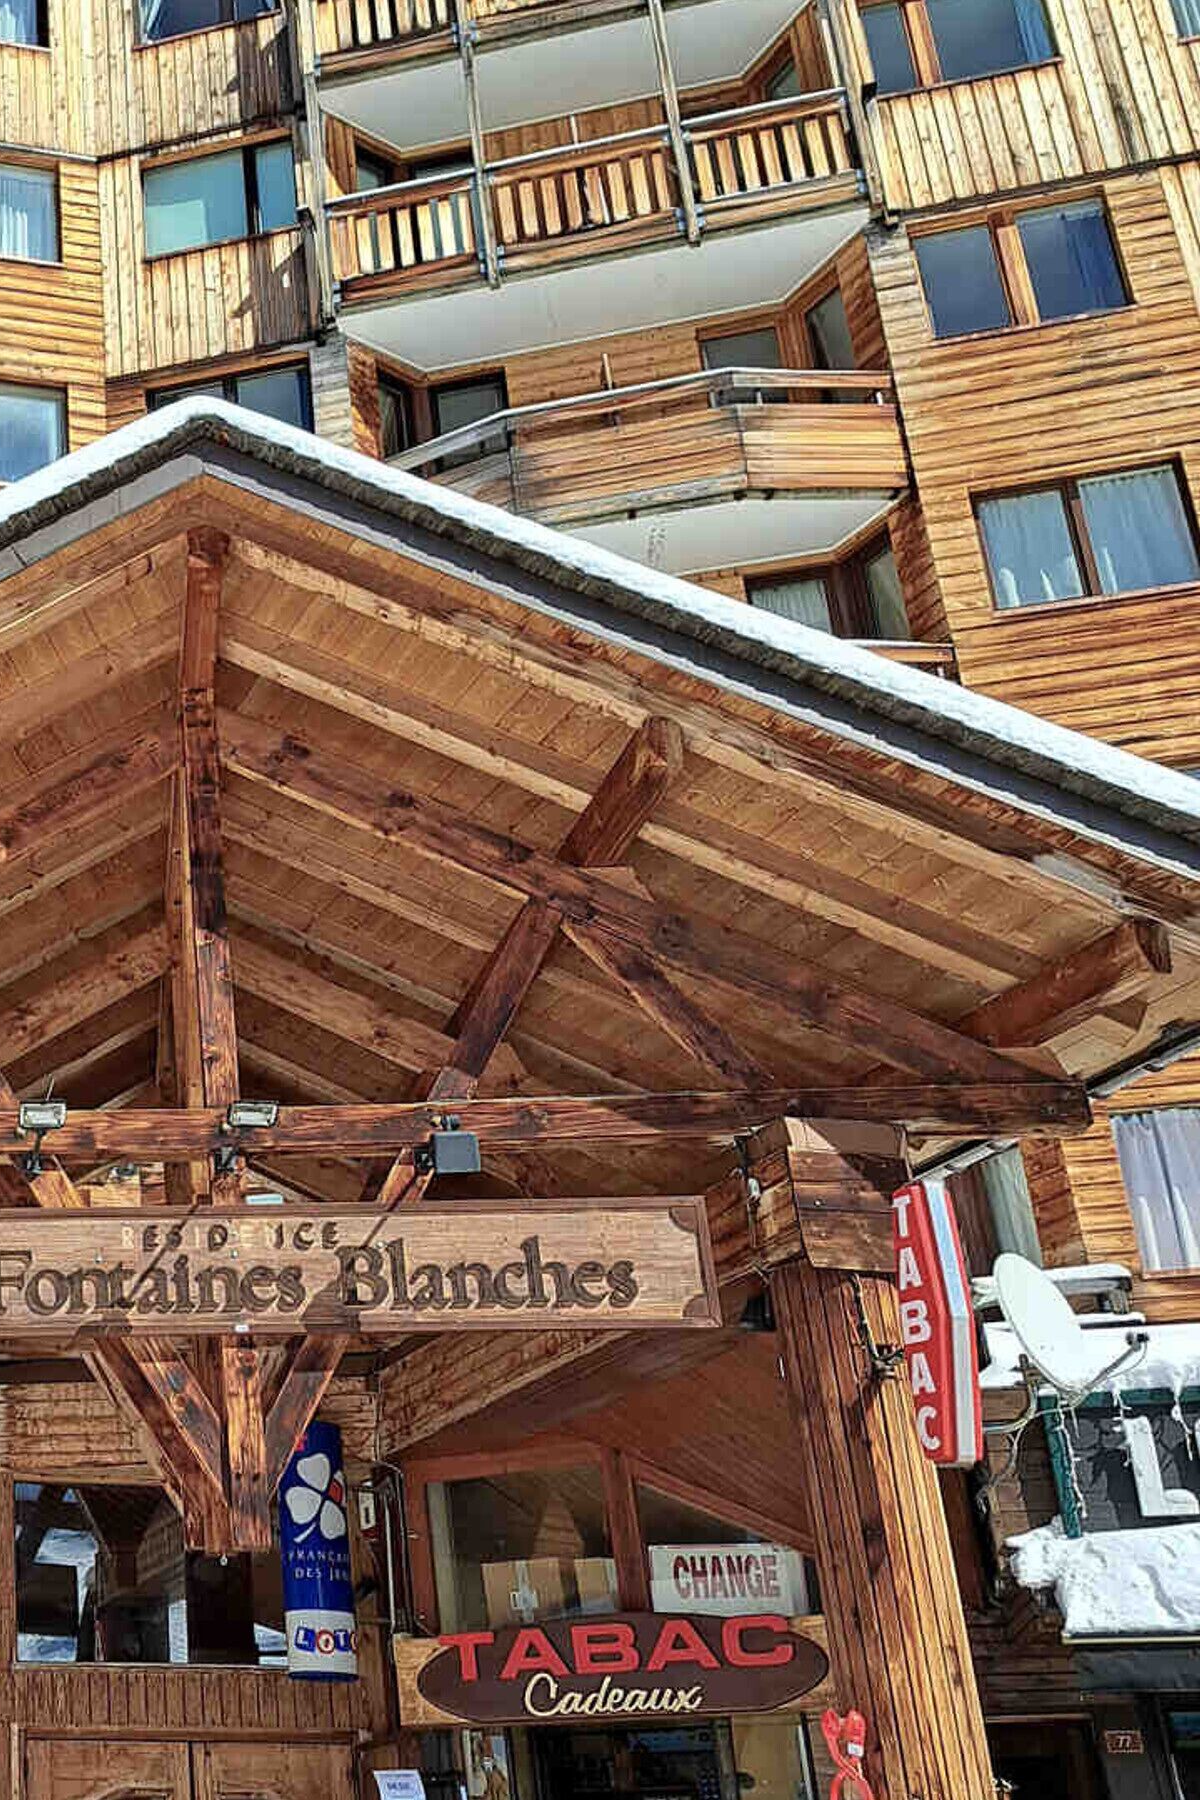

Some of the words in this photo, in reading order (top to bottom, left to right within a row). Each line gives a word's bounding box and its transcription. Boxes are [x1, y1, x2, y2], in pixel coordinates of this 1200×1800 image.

[334, 1234, 640, 1311] Blanches
[892, 1194, 942, 1451] TABAC
[294, 1566, 322, 1580] DES
[673, 1554, 781, 1600] CHANGE
[438, 1614, 795, 1683] TABAC
[524, 1672, 703, 1717] Cadeaux
